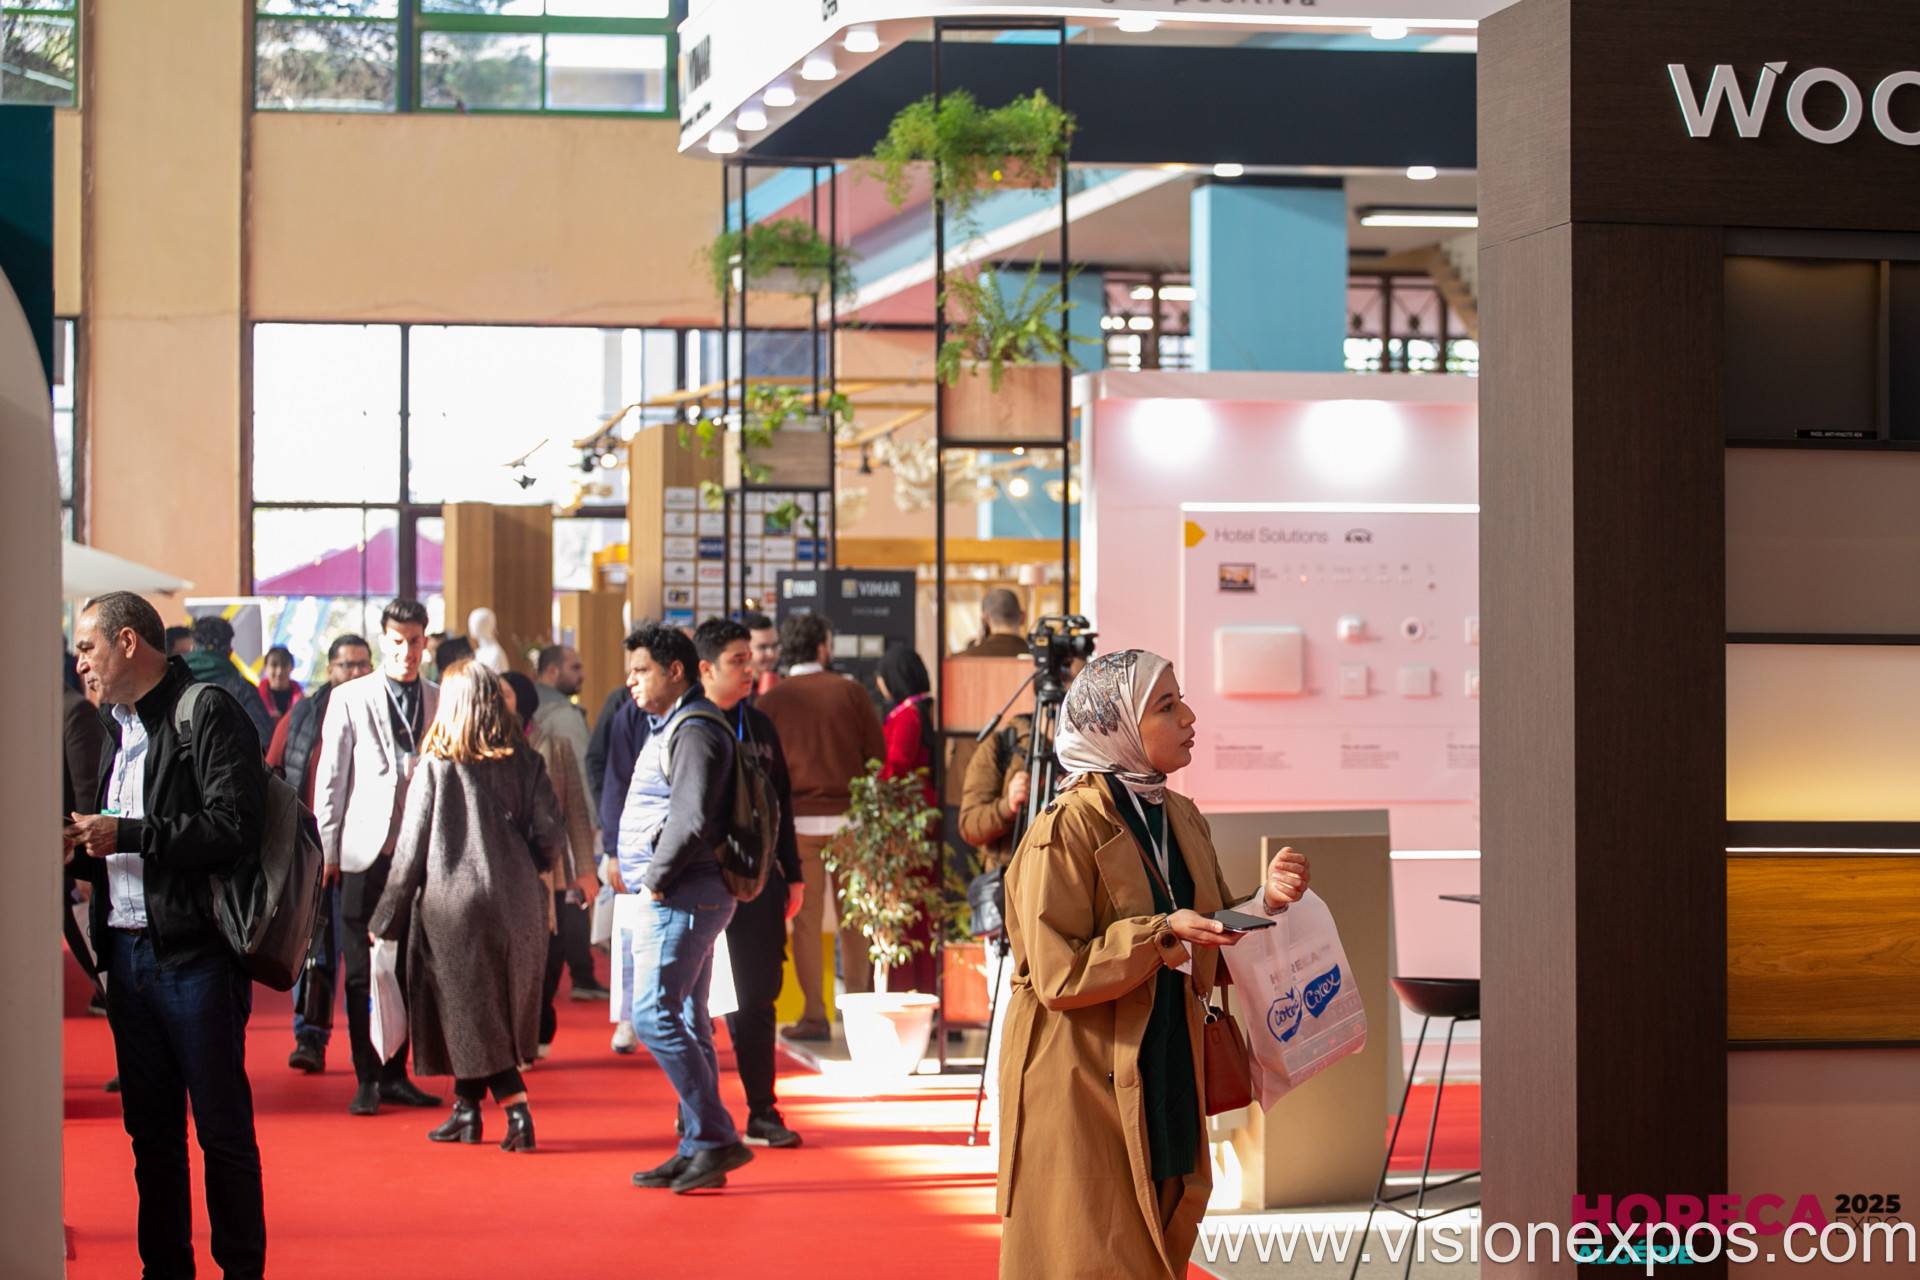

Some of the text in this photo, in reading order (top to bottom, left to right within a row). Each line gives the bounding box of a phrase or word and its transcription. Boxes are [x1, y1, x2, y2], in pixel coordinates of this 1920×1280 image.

[1213, 528, 1329, 543] Hotel Solutions
[859, 580, 901, 597] VIMAR
